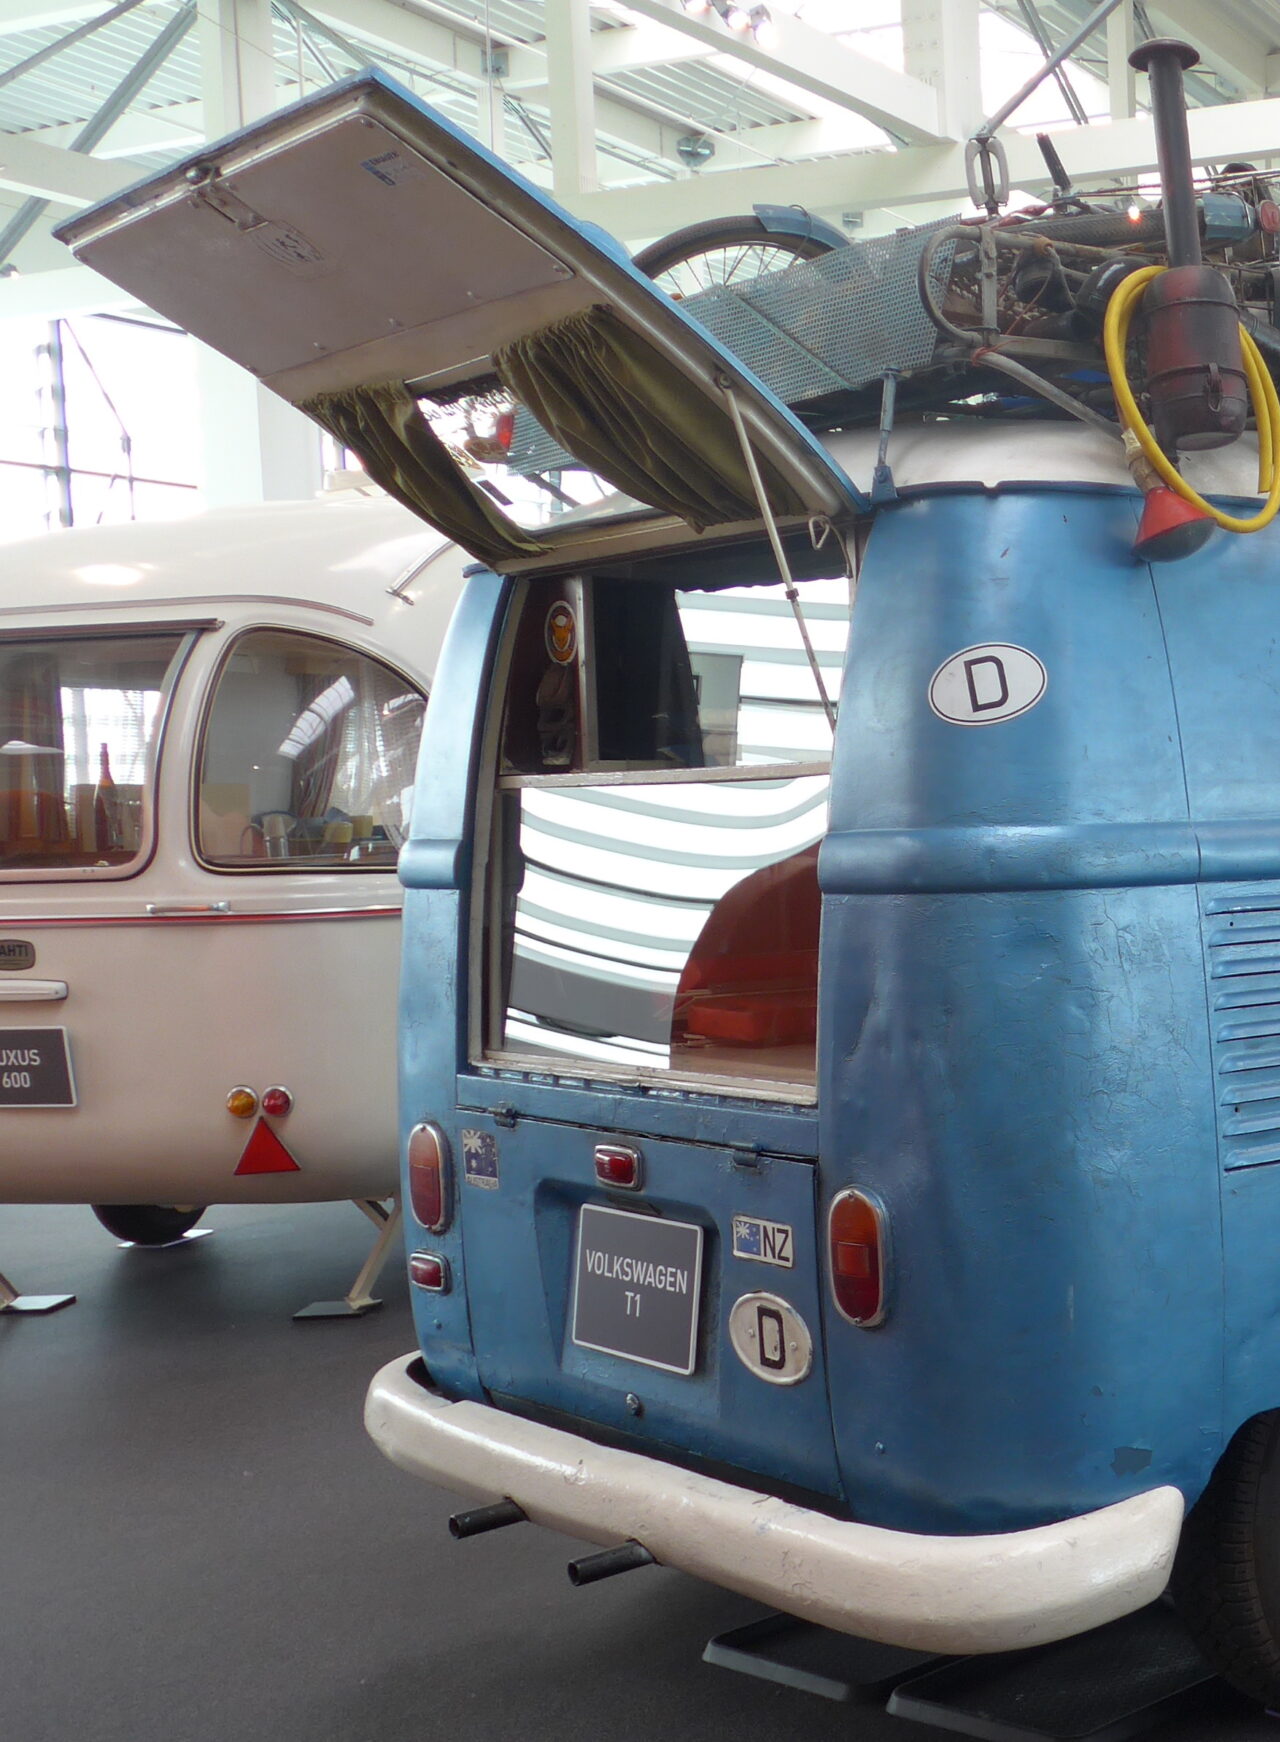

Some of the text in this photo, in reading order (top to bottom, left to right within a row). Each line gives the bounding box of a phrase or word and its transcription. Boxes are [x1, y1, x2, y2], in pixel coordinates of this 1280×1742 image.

[964, 655, 1009, 713] D
[2, 1072, 31, 1088] 600
[763, 1228, 791, 1263] NZ
[586, 1249, 688, 1295] VOLKSWAGEN
[625, 1291, 641, 1318] T1
[757, 1303, 786, 1370] D
